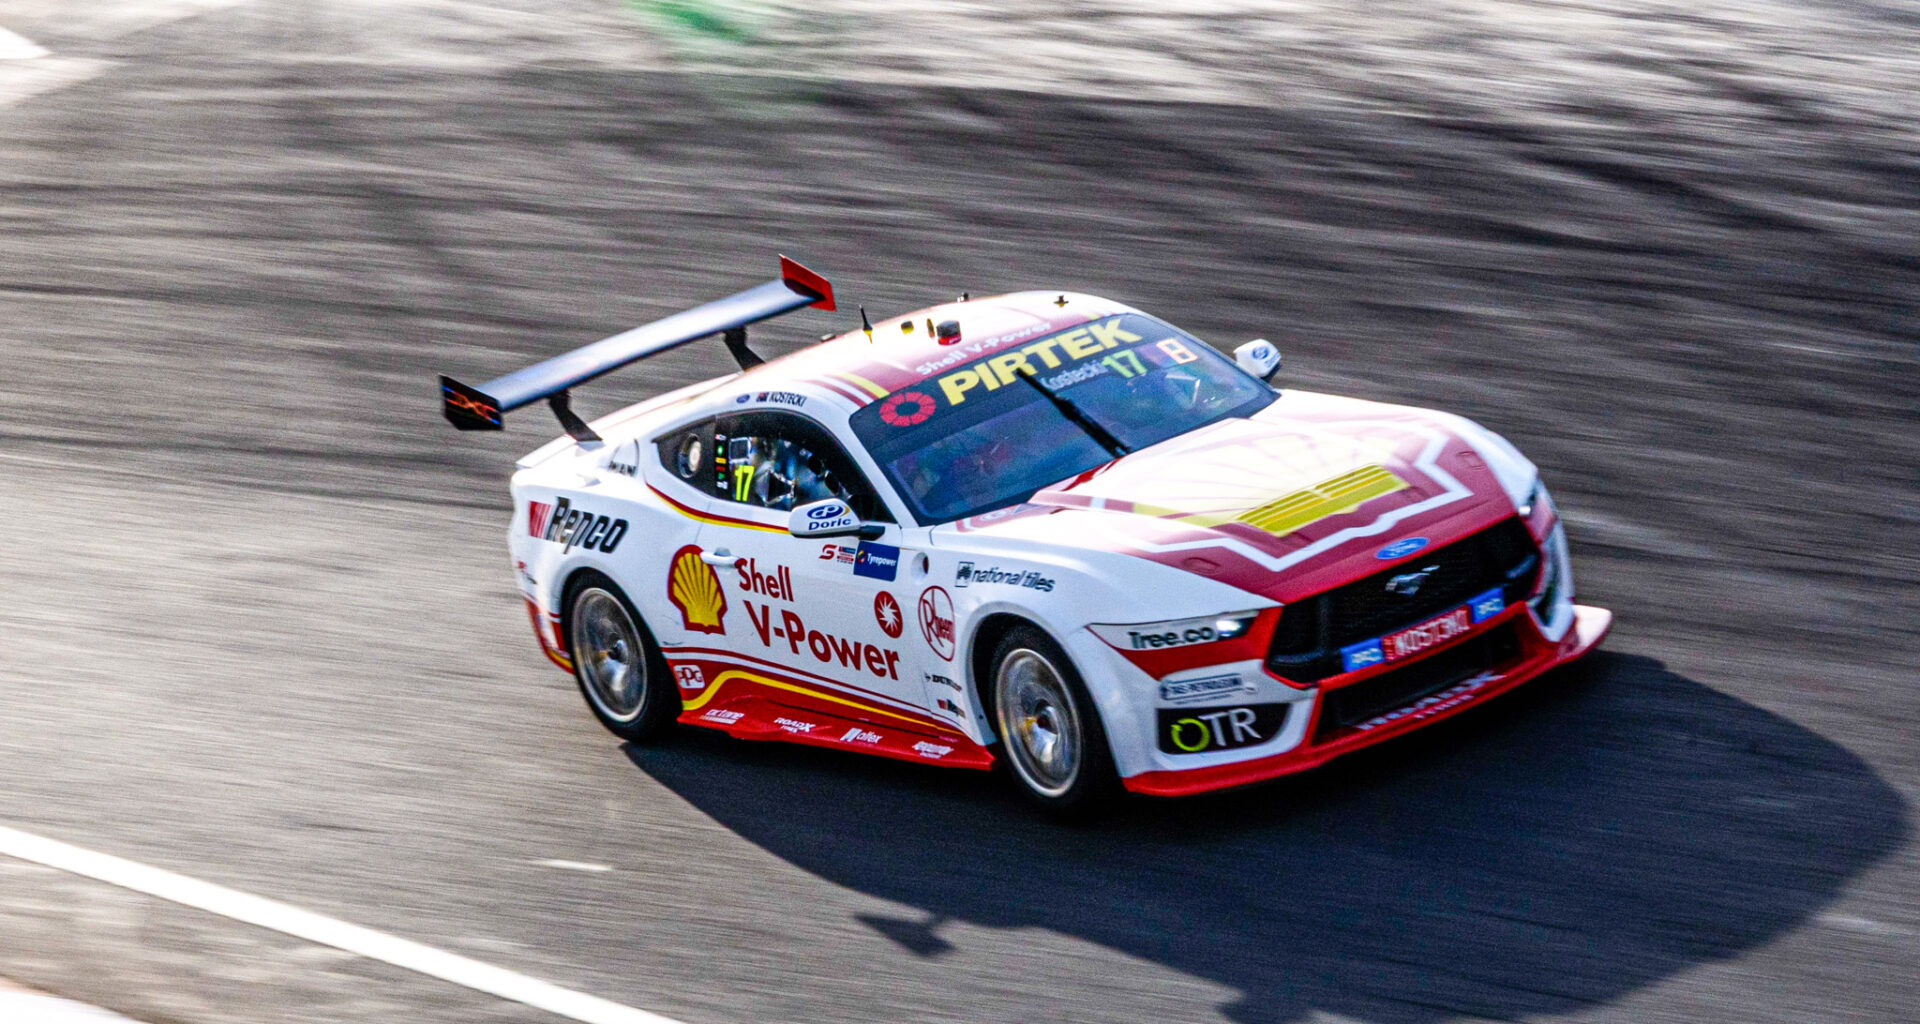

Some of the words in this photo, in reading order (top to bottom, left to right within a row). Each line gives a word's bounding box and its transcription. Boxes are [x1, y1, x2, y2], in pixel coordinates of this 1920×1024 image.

[917, 345, 967, 376] Shell
[967, 322, 1052, 355] V-Power
[937, 318, 1144, 407] PIRTEK
[1101, 349, 1148, 379] 17
[734, 465, 755, 502] 17
[546, 496, 629, 555] Repco
[808, 518, 851, 531] Doric
[734, 557, 795, 602] Shell
[972, 567, 1026, 584] national
[1022, 571, 1056, 592] tiles
[742, 599, 900, 681] V-Power
[1170, 708, 1263, 752] OTR
